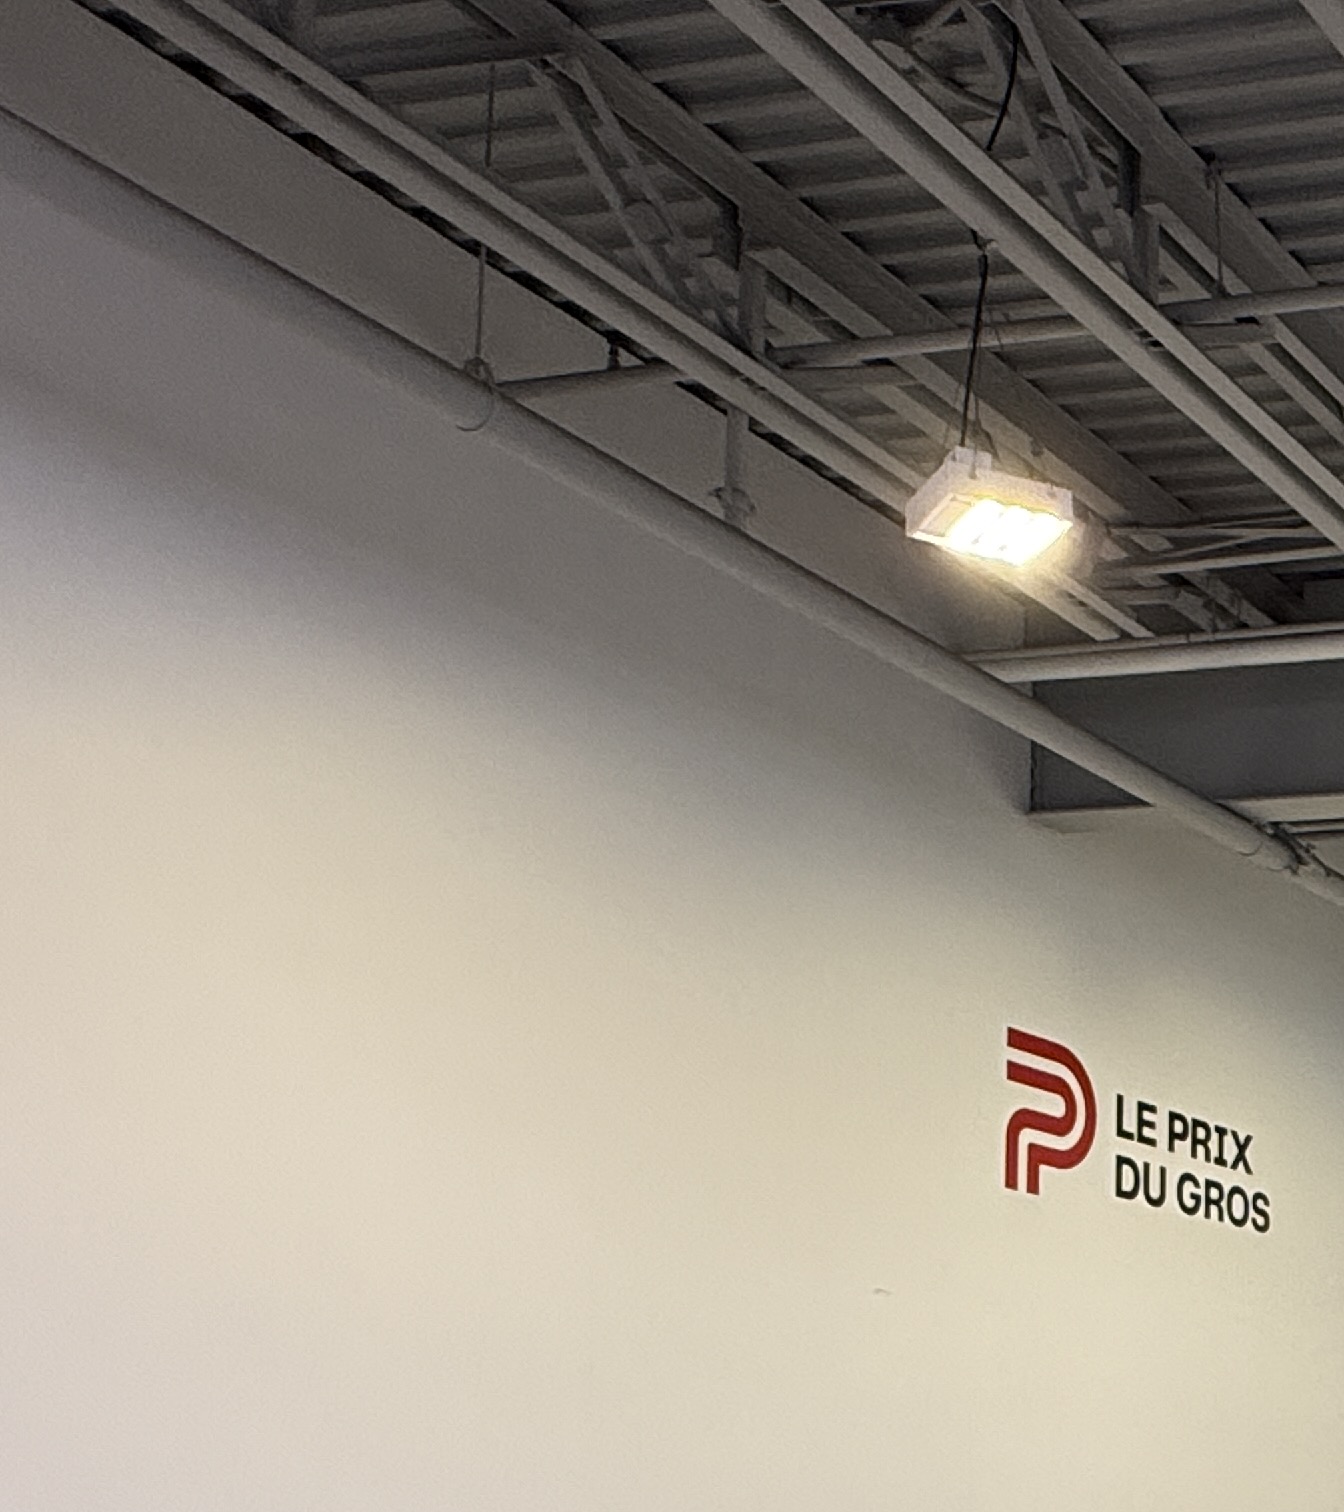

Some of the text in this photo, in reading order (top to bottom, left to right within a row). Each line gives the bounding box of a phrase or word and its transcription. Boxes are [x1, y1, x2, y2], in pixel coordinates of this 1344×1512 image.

[1115, 1093, 1253, 1175] LE PRIX
[1115, 1154, 1270, 1233] DU GROS
